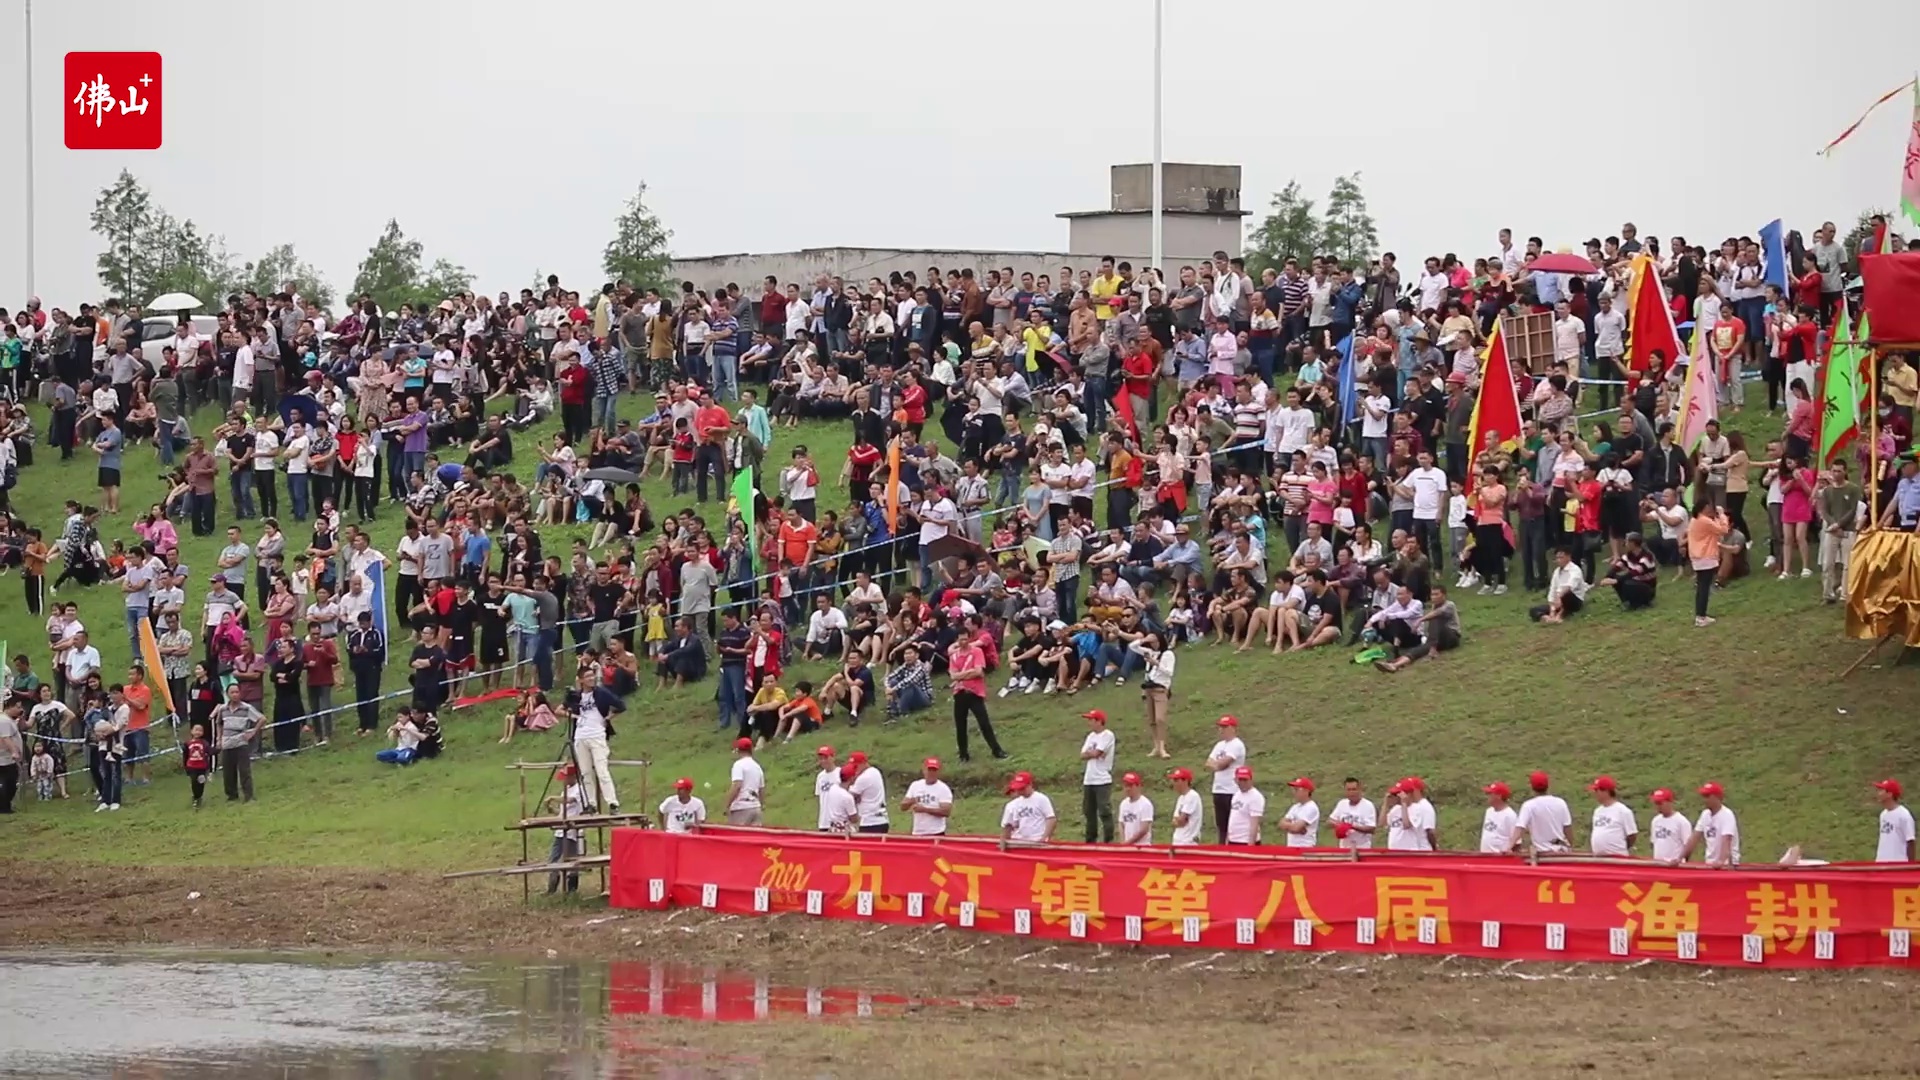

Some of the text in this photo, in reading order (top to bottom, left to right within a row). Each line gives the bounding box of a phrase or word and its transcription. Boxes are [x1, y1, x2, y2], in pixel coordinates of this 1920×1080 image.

[1130, 925, 1139, 938] 10
[1187, 926, 1196, 940] 11
[1241, 928, 1251, 942] 12
[1299, 929, 1308, 943] 13
[1362, 928, 1371, 942] 14
[1423, 927, 1433, 941] 15
[1487, 931, 1497, 945] 16
[1551, 933, 1561, 948] 17
[1614, 939, 1625, 953] 18
[1893, 939, 1906, 955] 22
[1682, 942, 1694, 956] 19
[1747, 945, 1759, 960] 20
[1819, 942, 1830, 957] 21
